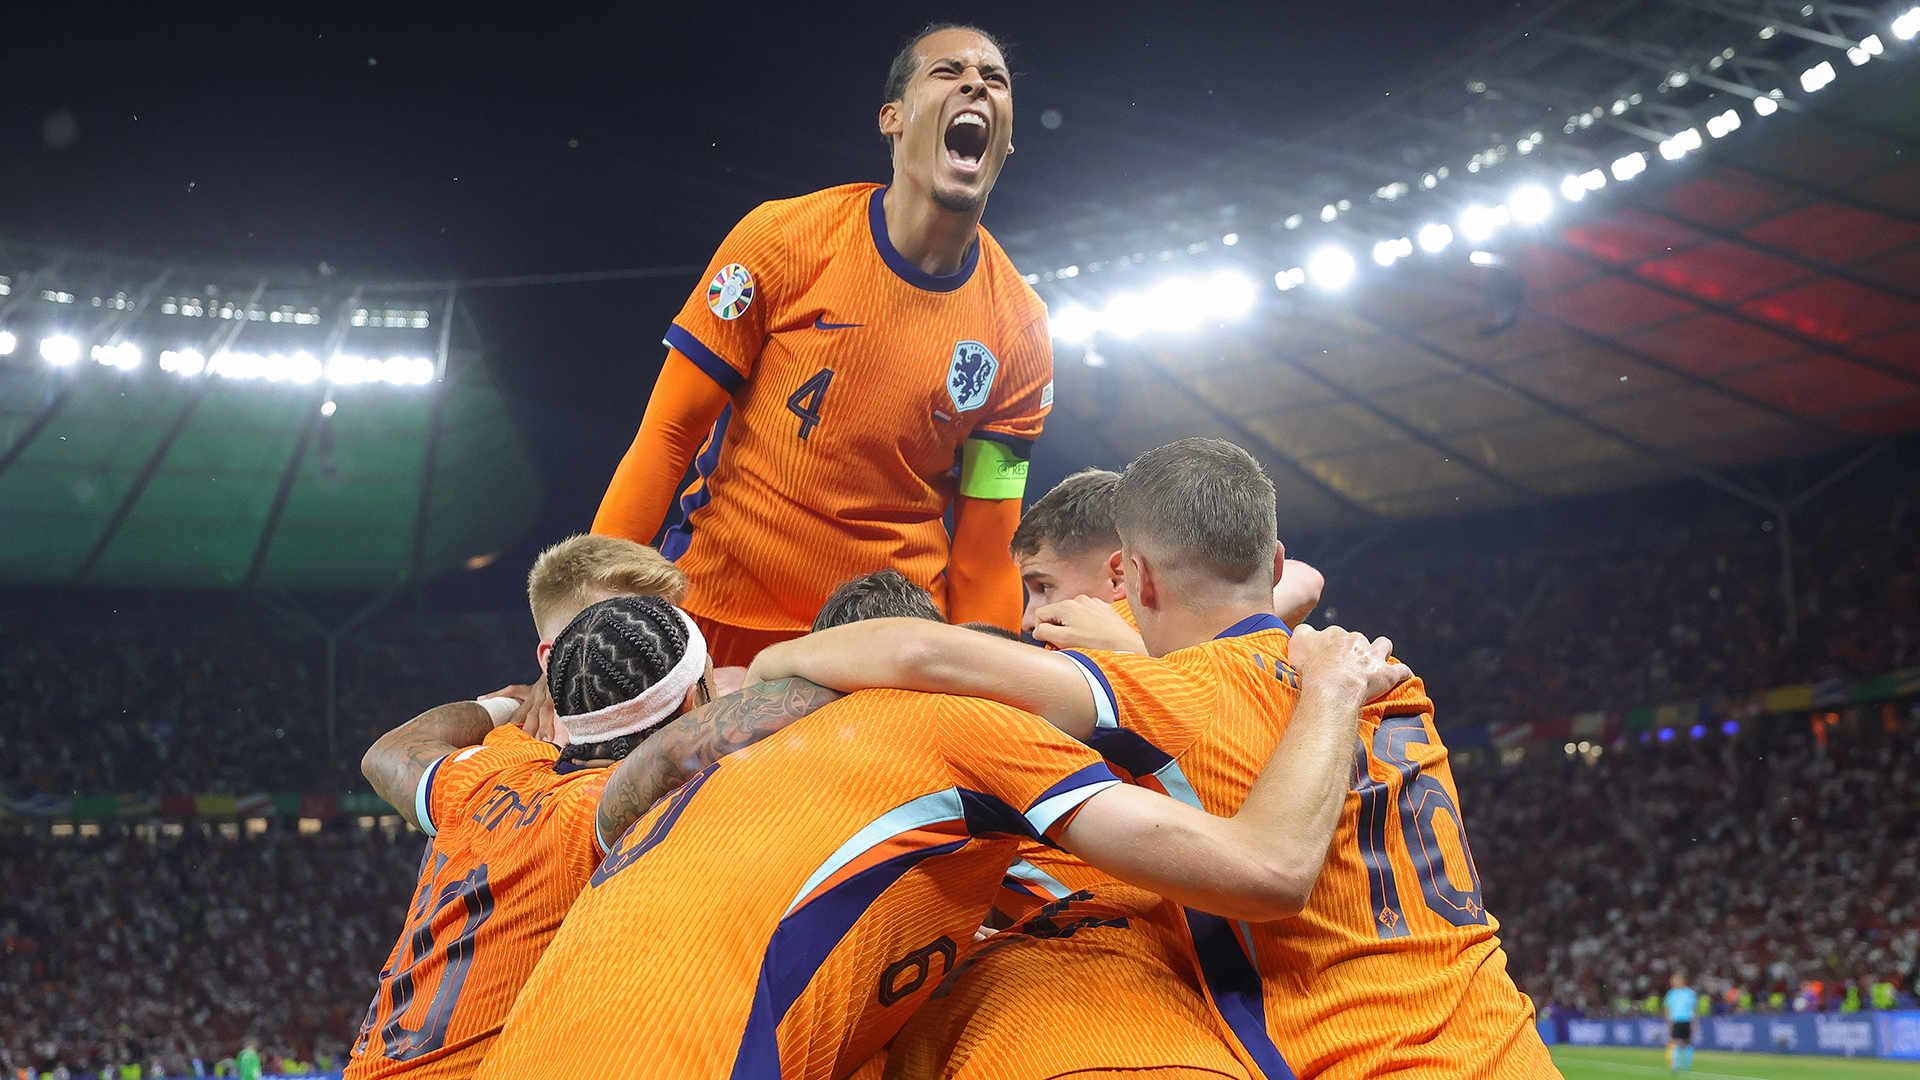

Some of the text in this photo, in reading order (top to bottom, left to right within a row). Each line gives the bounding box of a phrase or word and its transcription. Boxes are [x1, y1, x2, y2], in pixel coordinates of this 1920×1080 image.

[787, 367, 835, 441] 4
[1012, 464, 1029, 476] RES
[1350, 713, 1489, 940] 16
